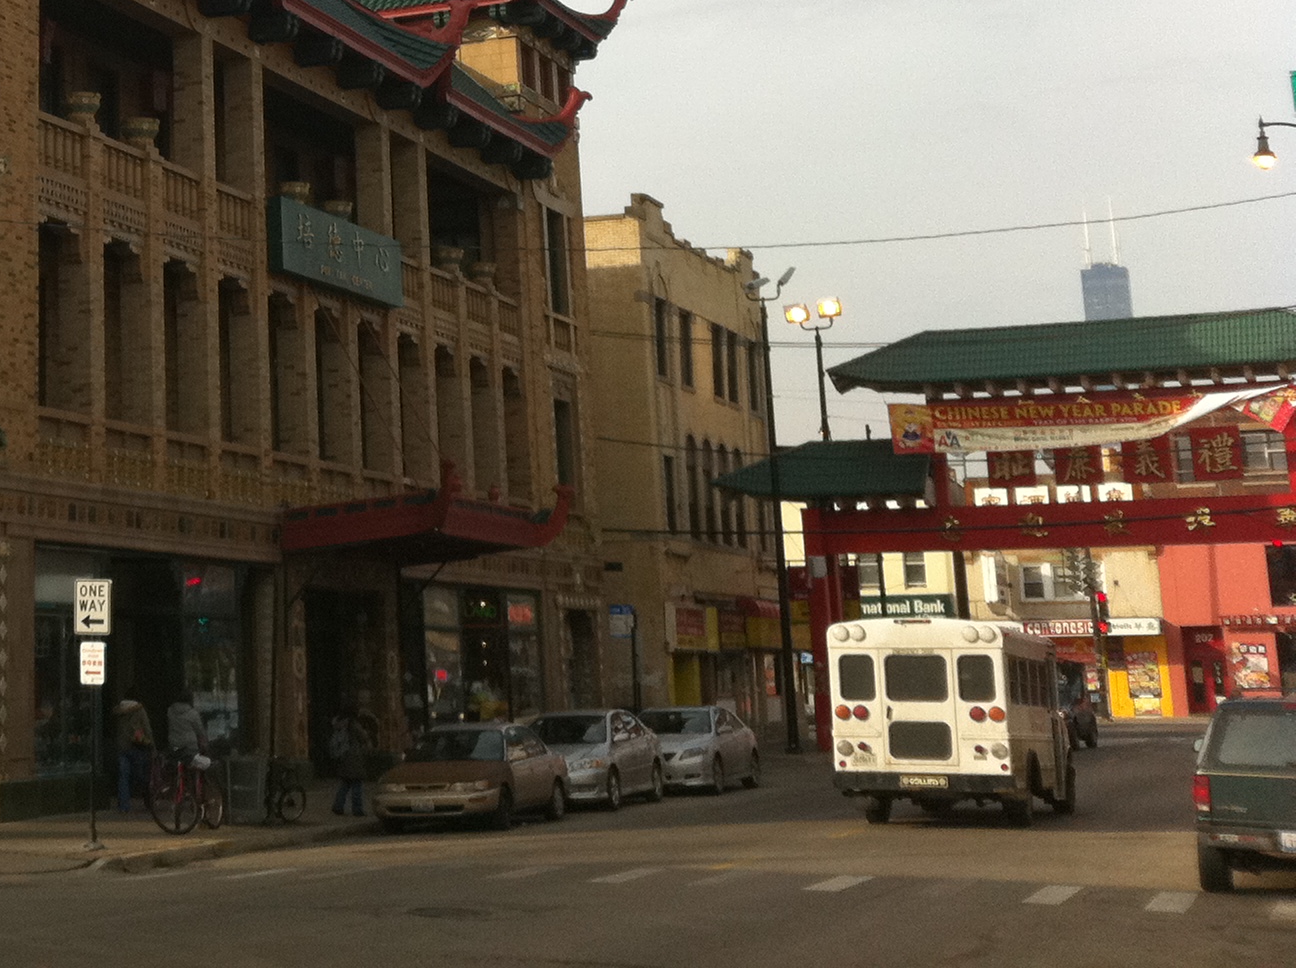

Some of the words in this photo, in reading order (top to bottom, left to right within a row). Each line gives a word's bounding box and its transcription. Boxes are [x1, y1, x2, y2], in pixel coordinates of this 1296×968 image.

[935, 405, 1009, 420] CHINESE
[1015, 405, 1054, 419] NEW
[1060, 402, 1106, 417] YEAR
[1111, 400, 1183, 416] PARADE
[1197, 432, 1238, 473] 禮
[80, 585, 105, 597] ONE
[79, 600, 105, 612] WAY
[914, 599, 945, 613] Bank
